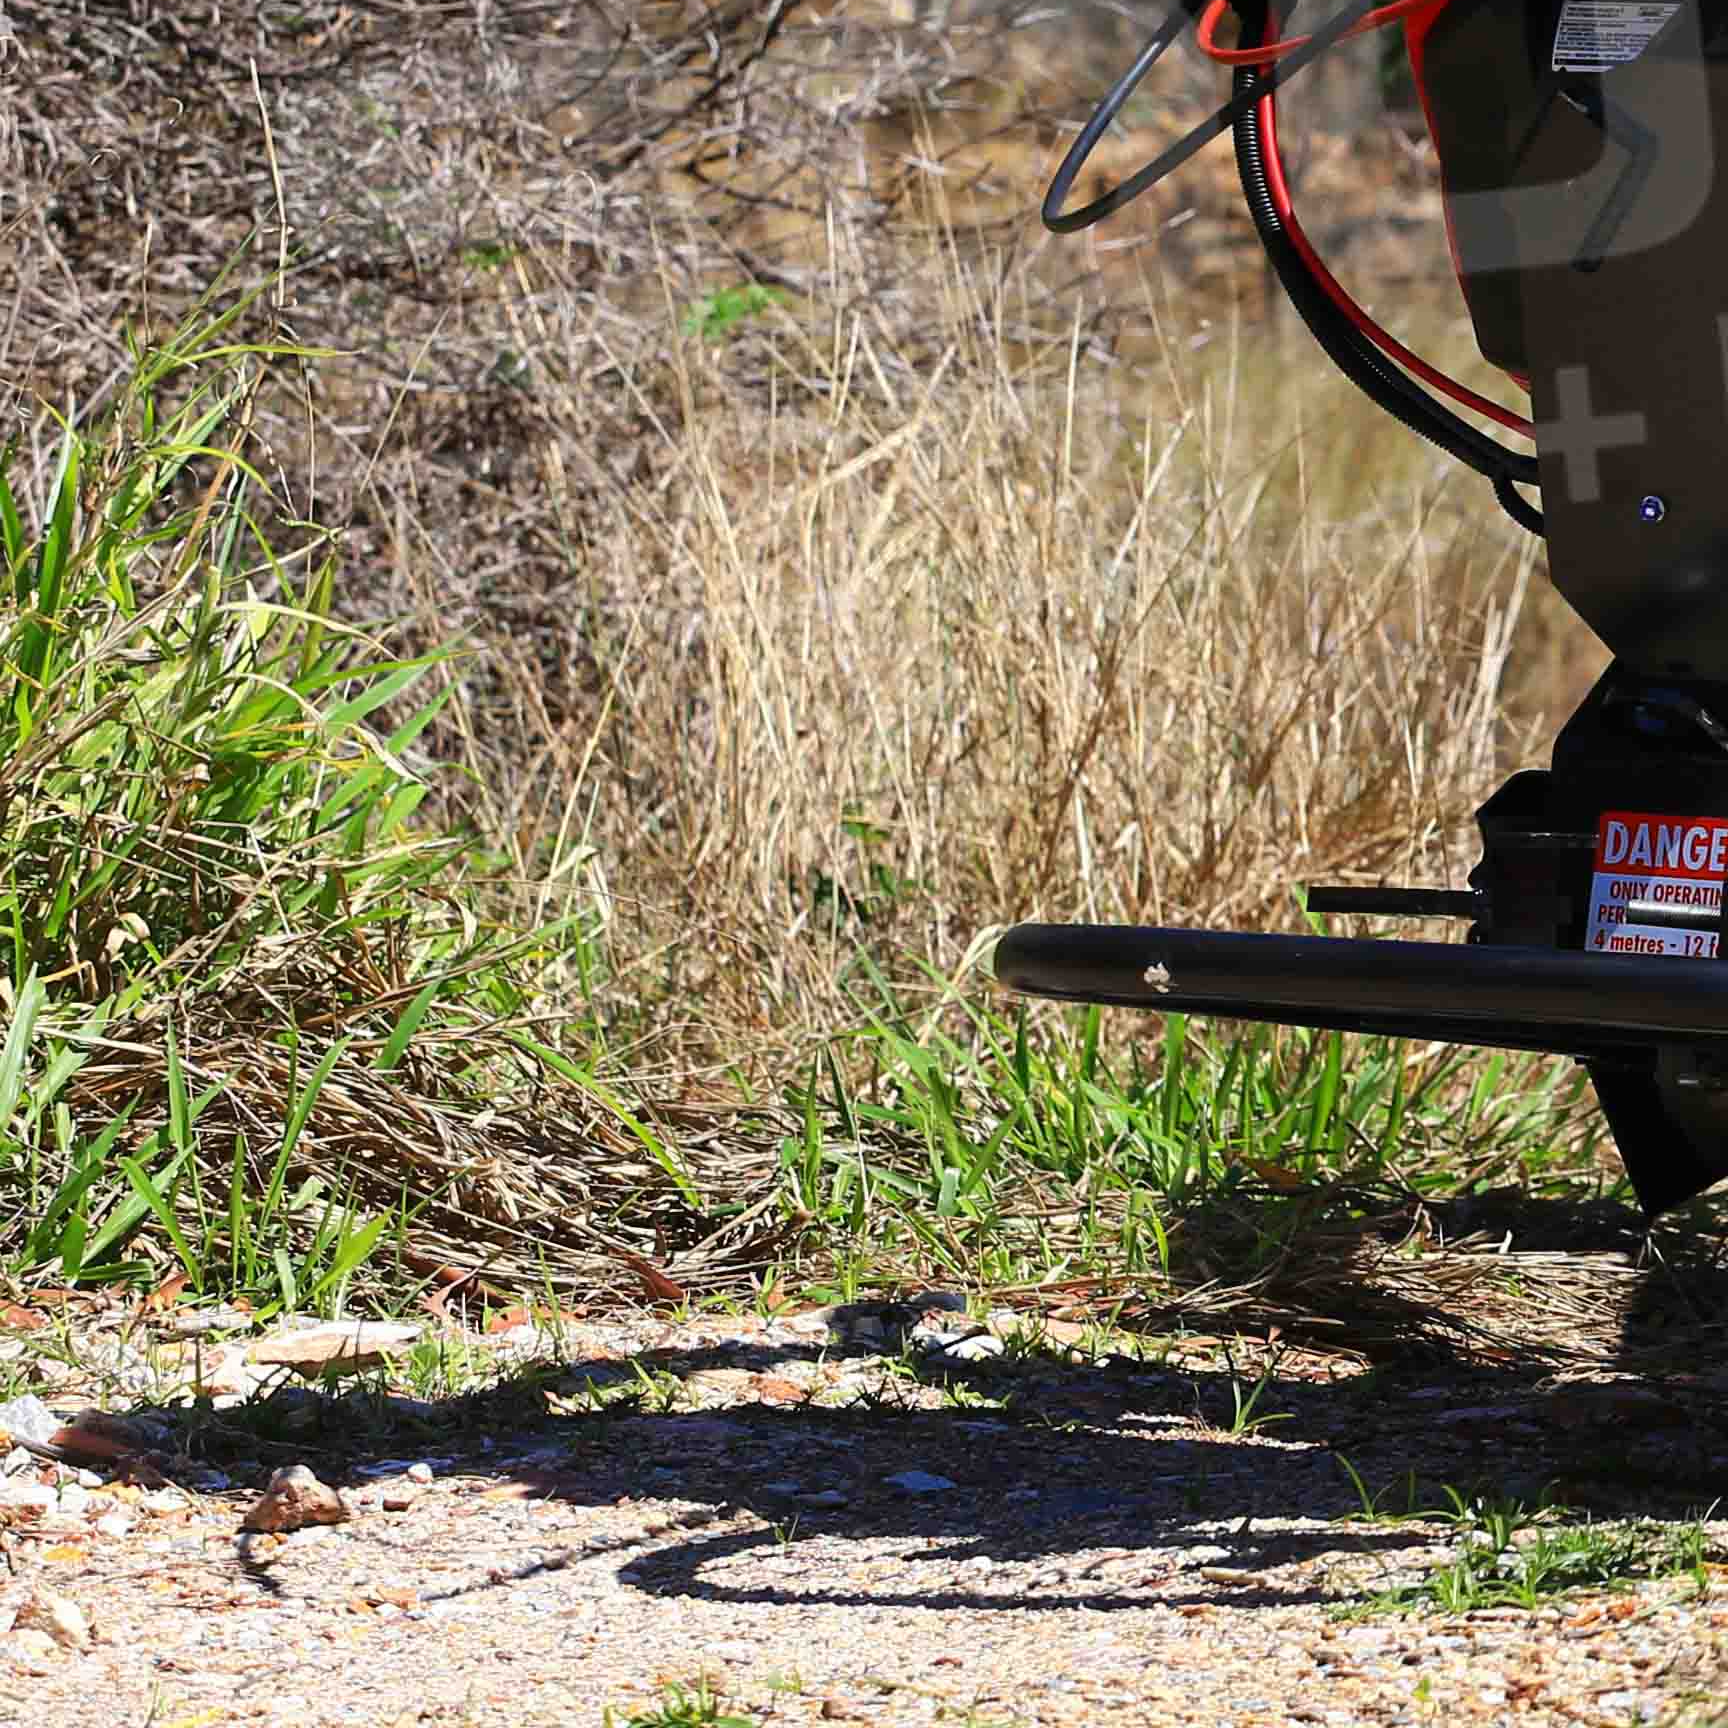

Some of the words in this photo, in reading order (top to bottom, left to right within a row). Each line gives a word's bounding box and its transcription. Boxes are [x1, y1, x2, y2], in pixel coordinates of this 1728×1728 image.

[1610, 880, 1649, 901] ONLY
[1653, 883, 1721, 906] OPERATIN
[1594, 928, 1607, 950] 4
[1610, 933, 1664, 954] metres
[1684, 935, 1704, 958] 12
